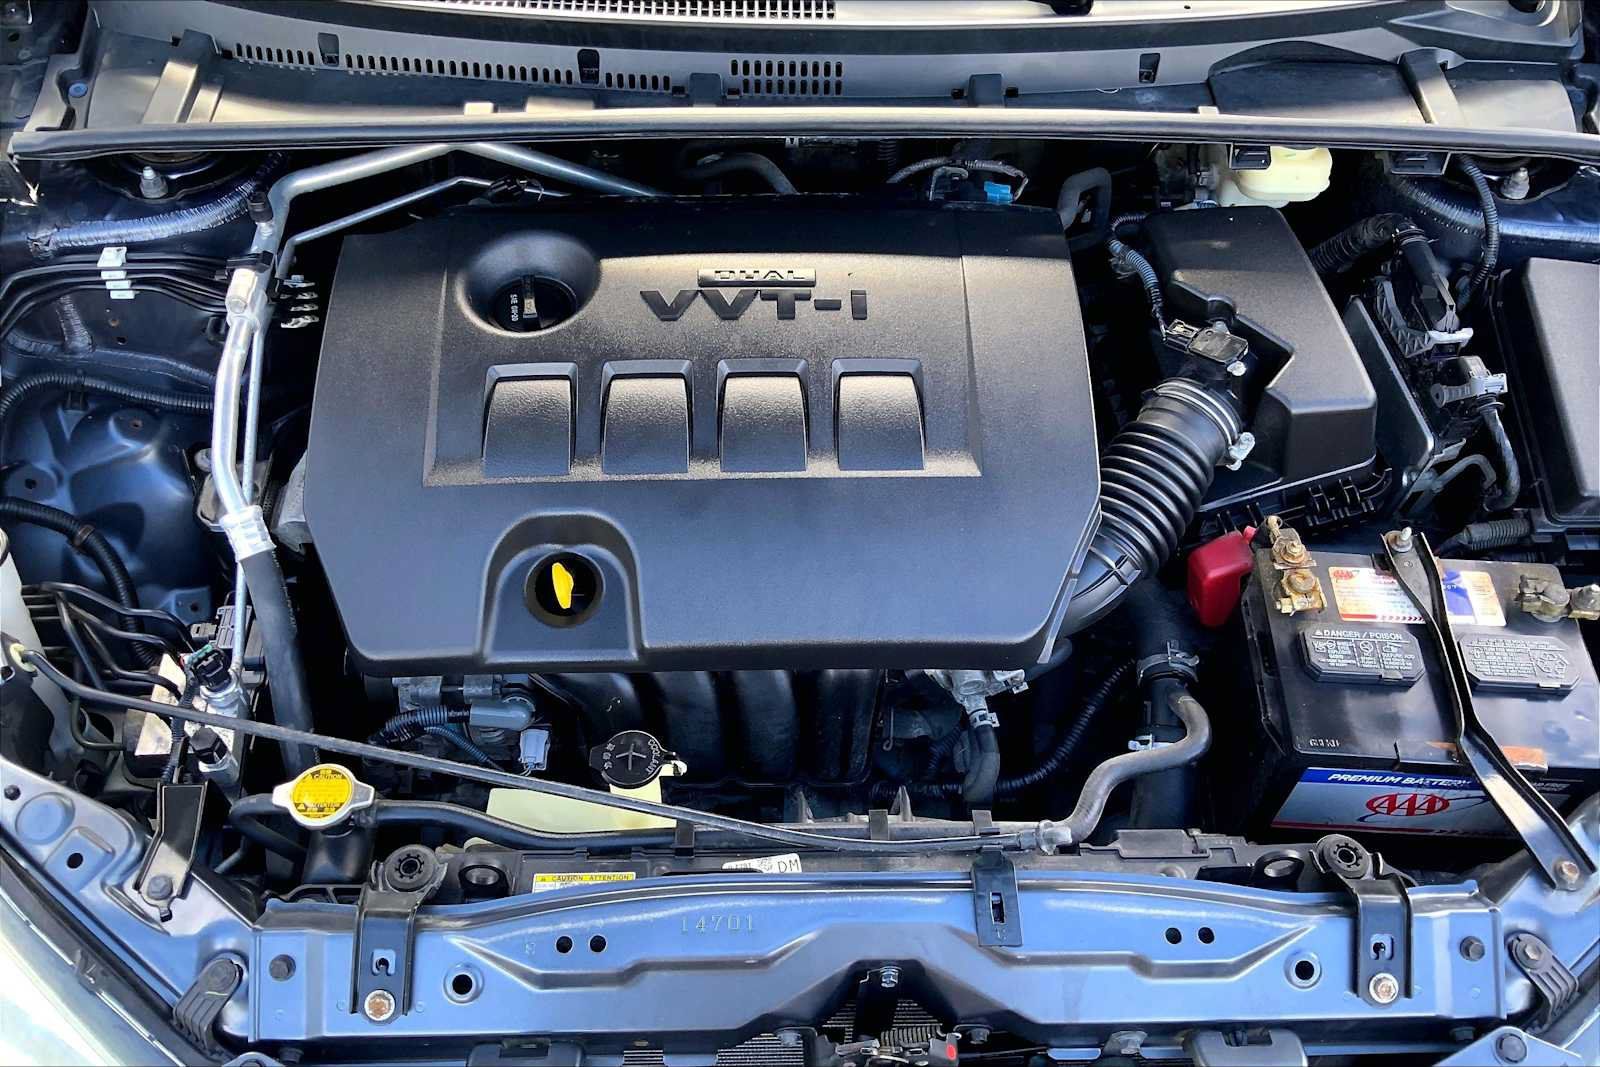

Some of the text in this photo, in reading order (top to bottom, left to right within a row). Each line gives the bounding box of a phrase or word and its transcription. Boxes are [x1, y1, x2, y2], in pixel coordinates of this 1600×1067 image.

[714, 269, 805, 281] DUAL
[1323, 629, 1361, 639] DANGER
[1368, 631, 1403, 641] POISON
[645, 739, 661, 775] COOLANT
[1328, 773, 1403, 785] PREMIUM
[1370, 792, 1446, 817] AAA
[778, 858, 800, 873] DM
[552, 872, 629, 882] CAUTION ATTENTION
[681, 912, 753, 935] 14701
